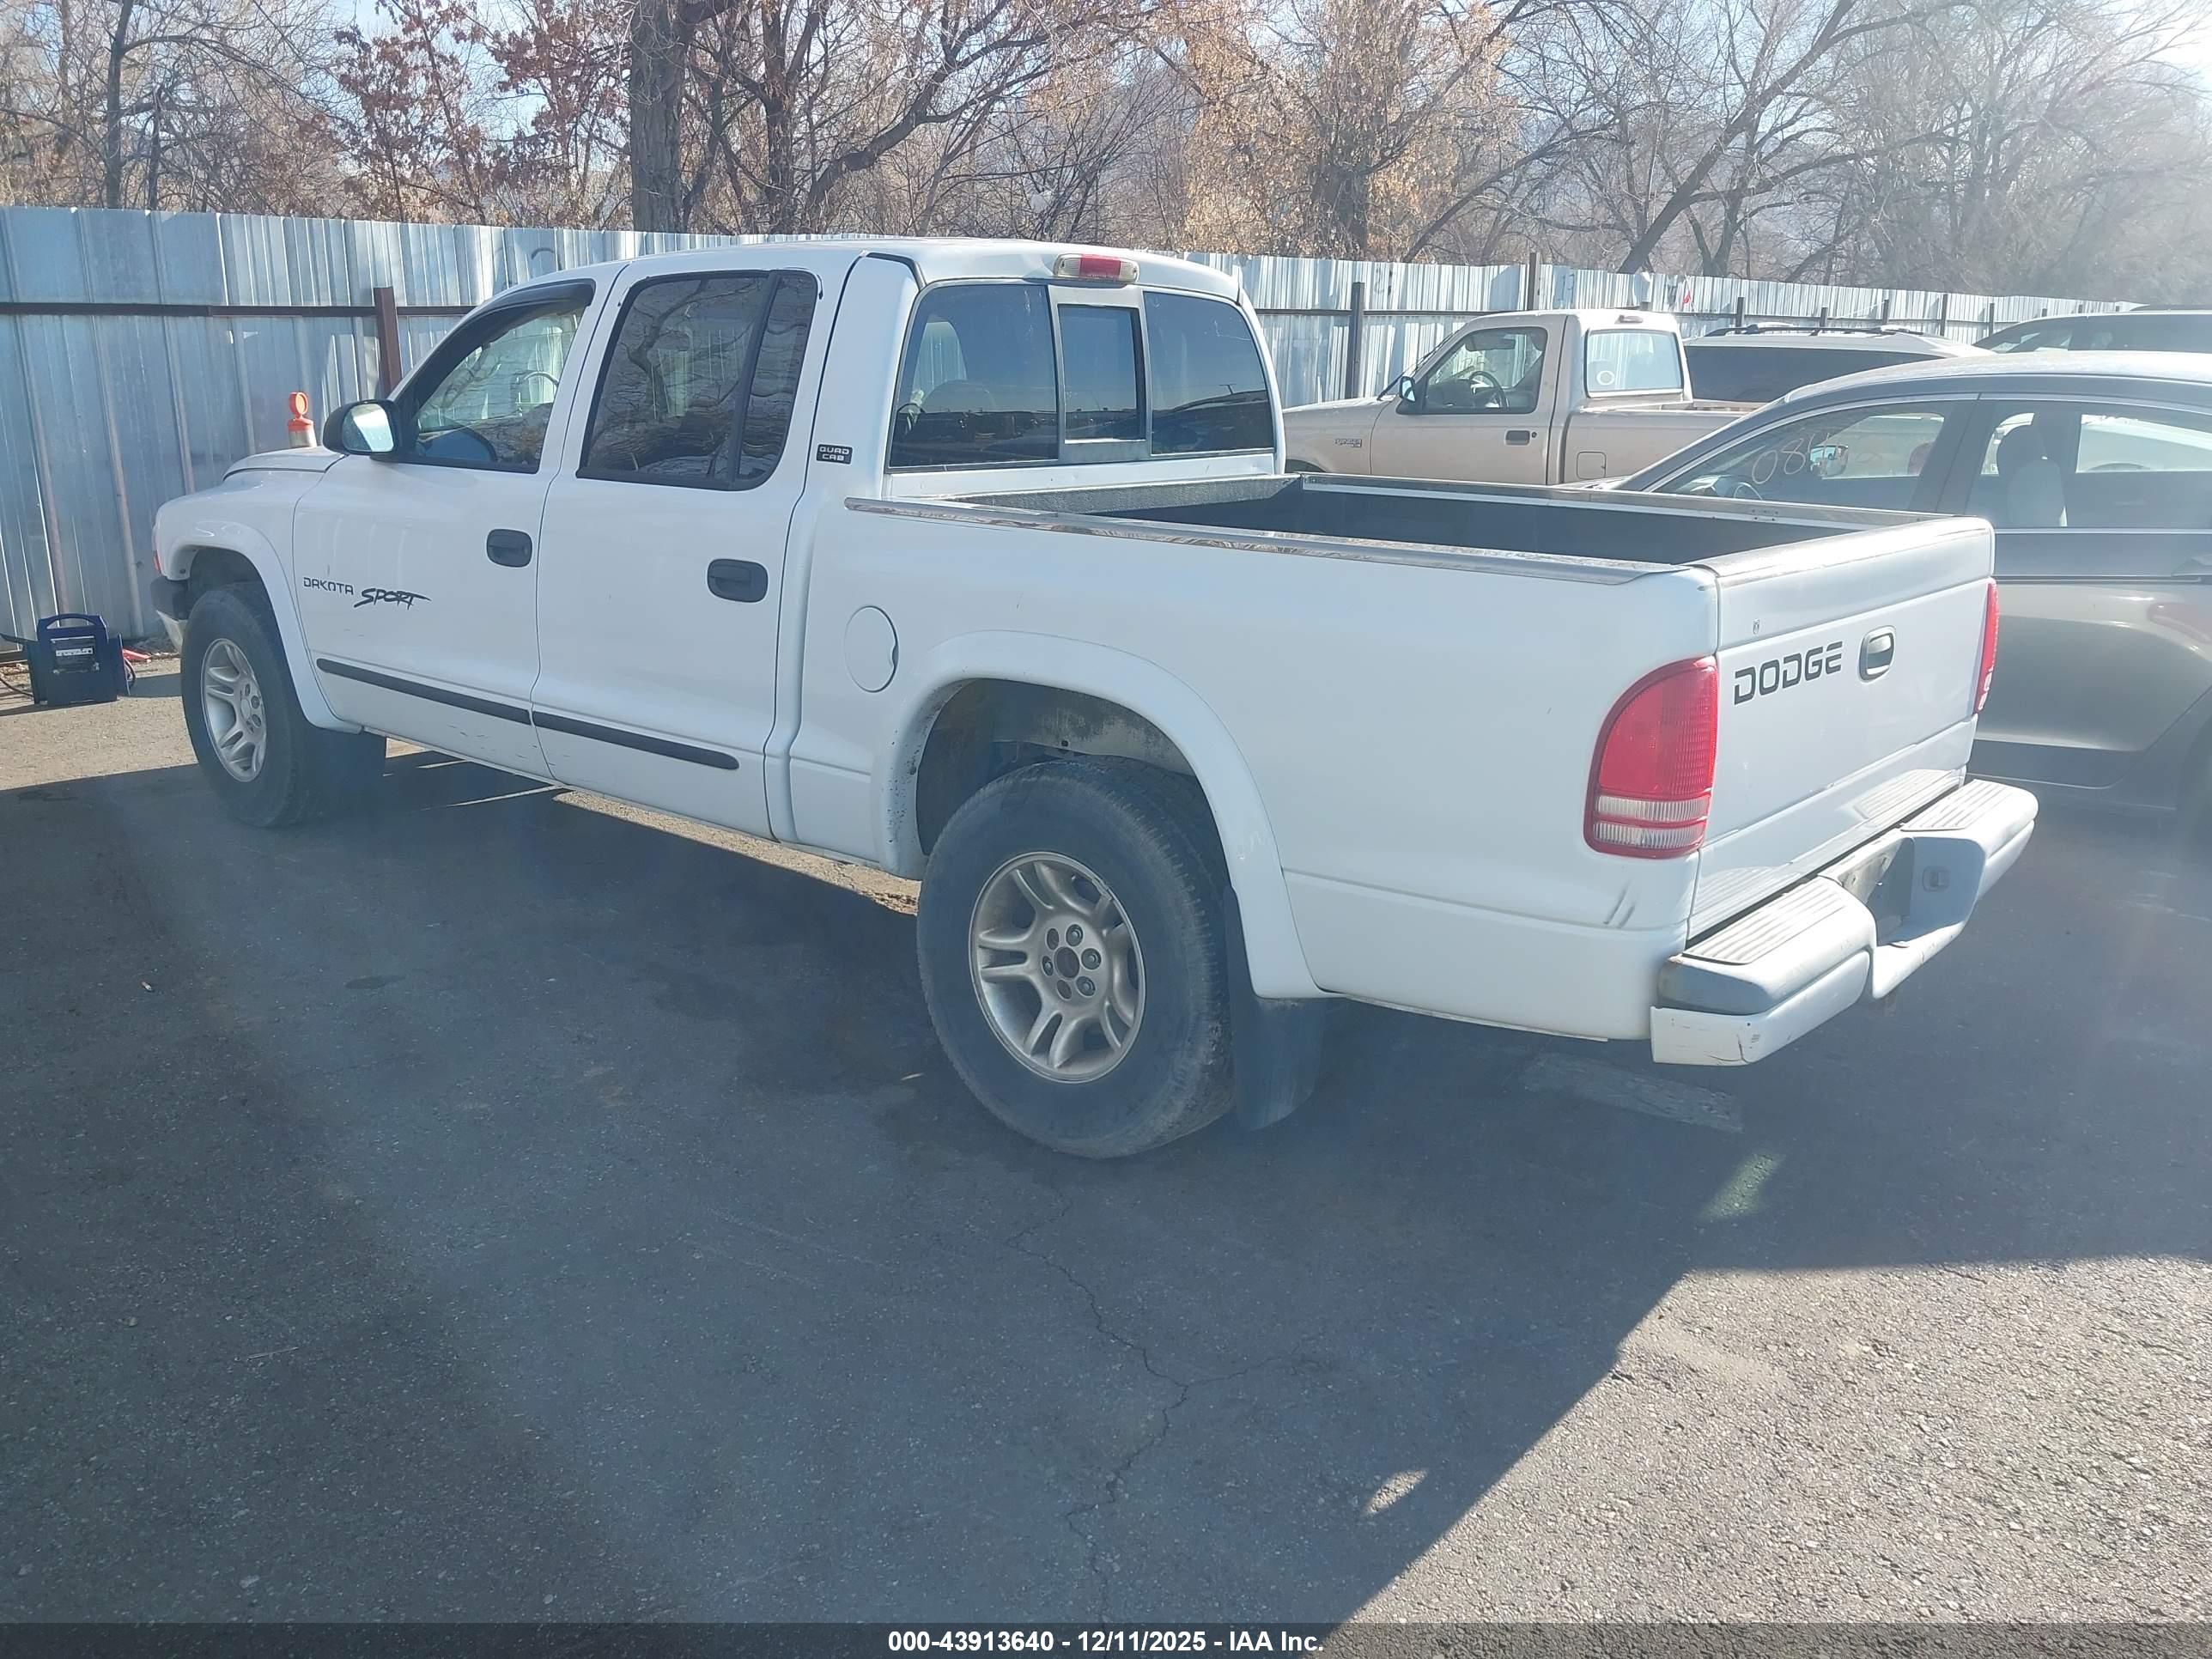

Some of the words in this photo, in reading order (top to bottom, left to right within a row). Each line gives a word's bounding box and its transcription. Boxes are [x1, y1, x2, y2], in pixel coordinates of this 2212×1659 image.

[819, 447, 850, 455] QUAD
[303, 577, 354, 596] DAKOTA
[353, 587, 432, 611] SPORT
[1734, 641, 1843, 706] DODGE
